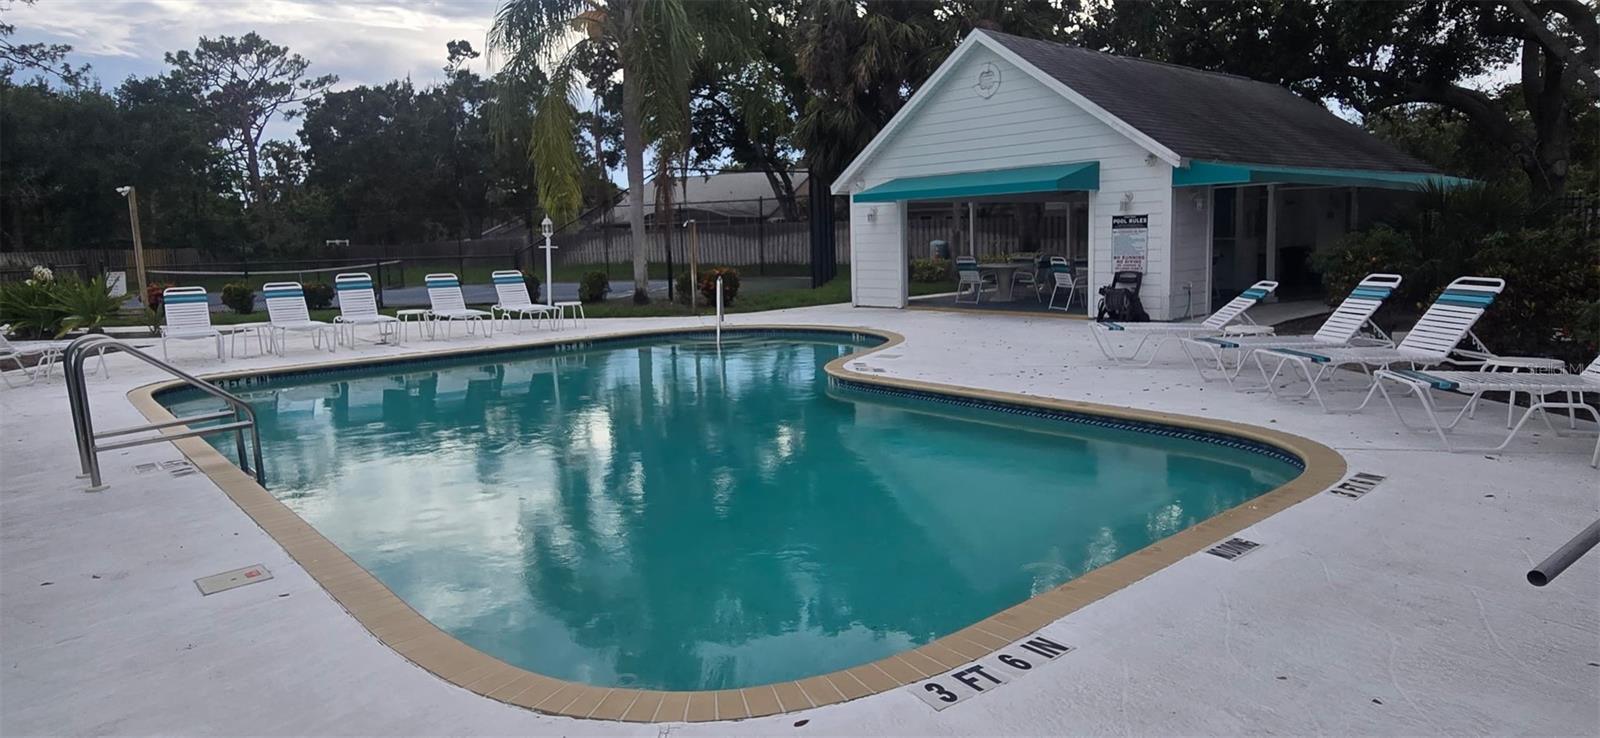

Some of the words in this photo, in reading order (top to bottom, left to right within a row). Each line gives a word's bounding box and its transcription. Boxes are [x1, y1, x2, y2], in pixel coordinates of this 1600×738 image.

[1337, 482, 1369, 494] FT
[924, 682, 958, 703] 3
[951, 664, 1002, 692] FT
[998, 654, 1033, 670] 6
[1020, 636, 1070, 659] IN
